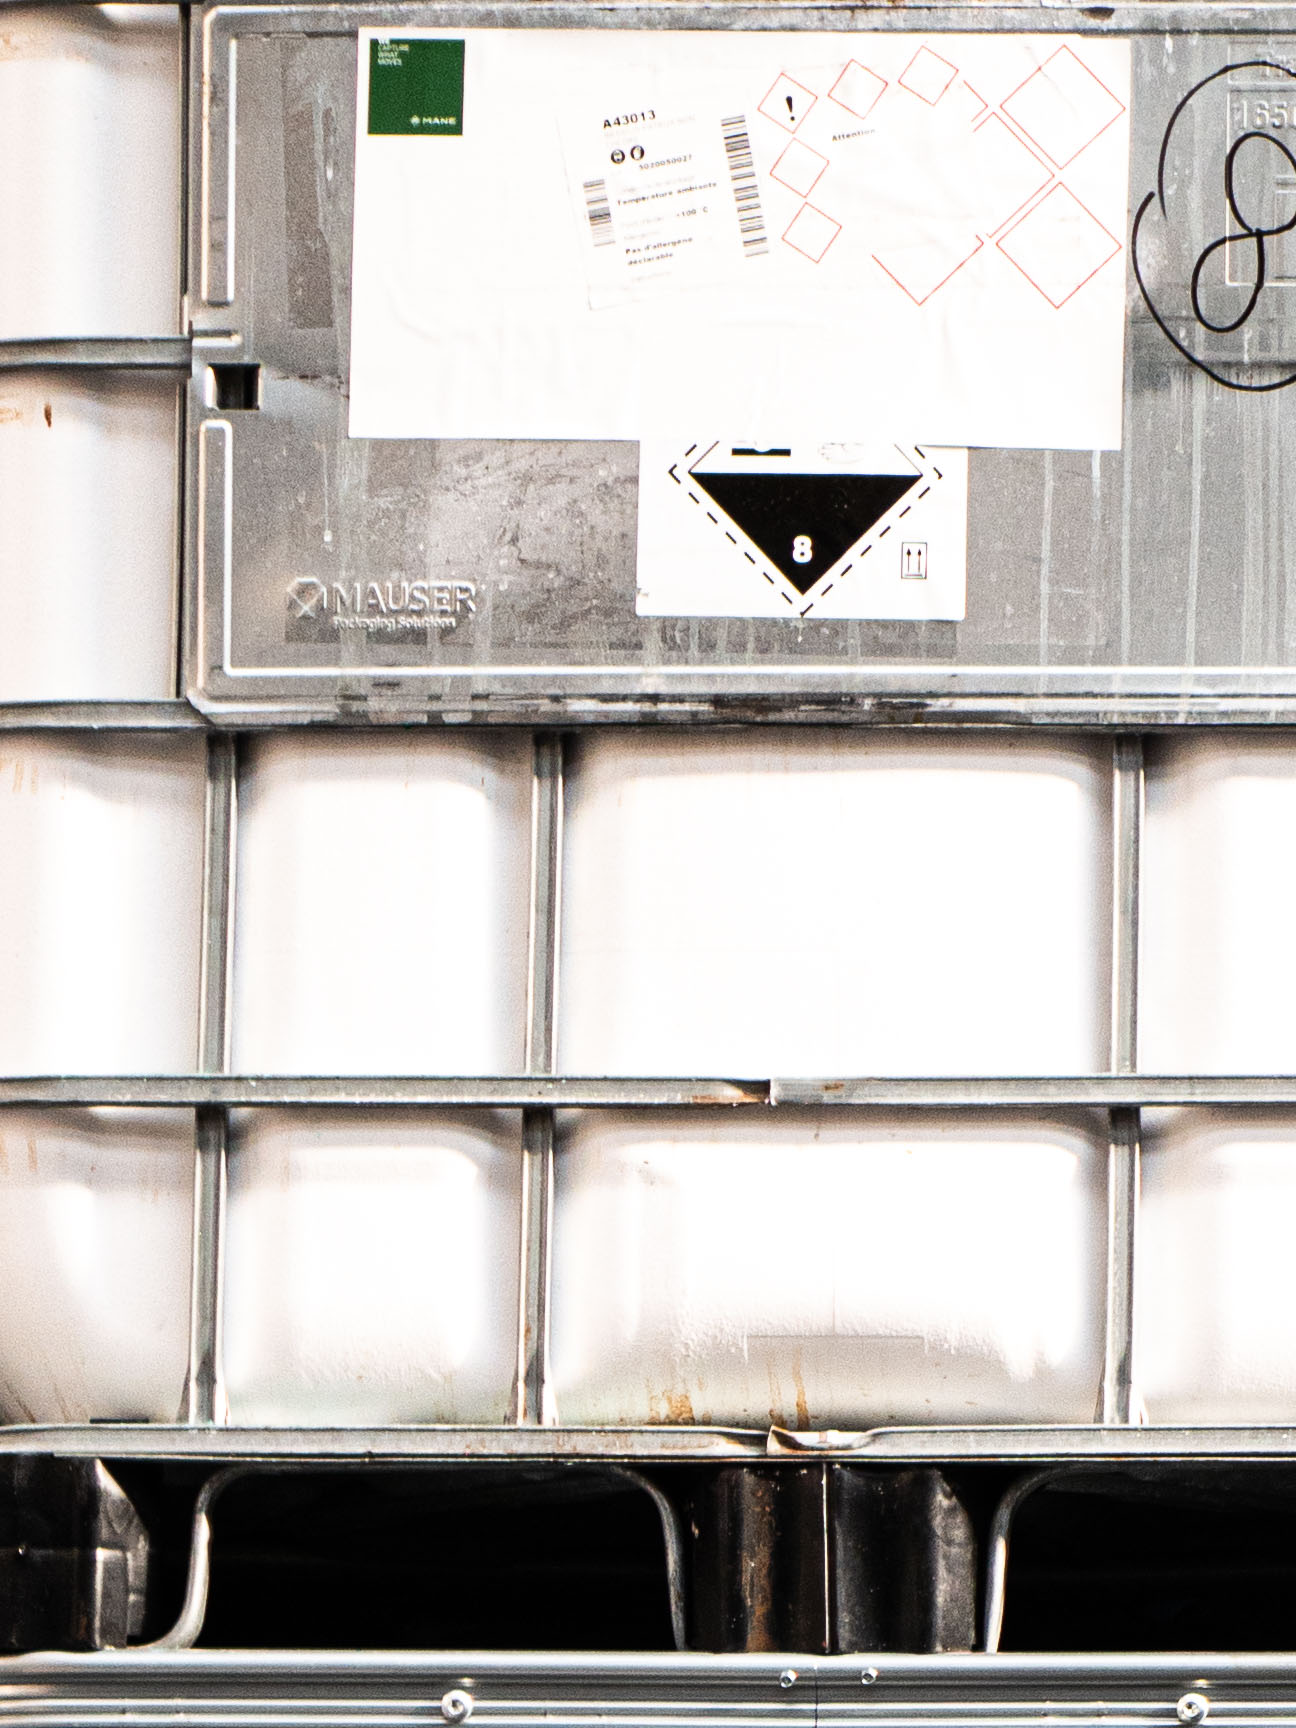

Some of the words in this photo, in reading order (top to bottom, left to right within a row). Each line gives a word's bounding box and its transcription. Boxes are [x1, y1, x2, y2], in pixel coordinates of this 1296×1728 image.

[422, 115, 457, 126] MANE
[602, 109, 656, 130] A43013
[831, 128, 876, 142] Attention
[792, 534, 813, 563] 8
[333, 581, 477, 614] MAUSER
